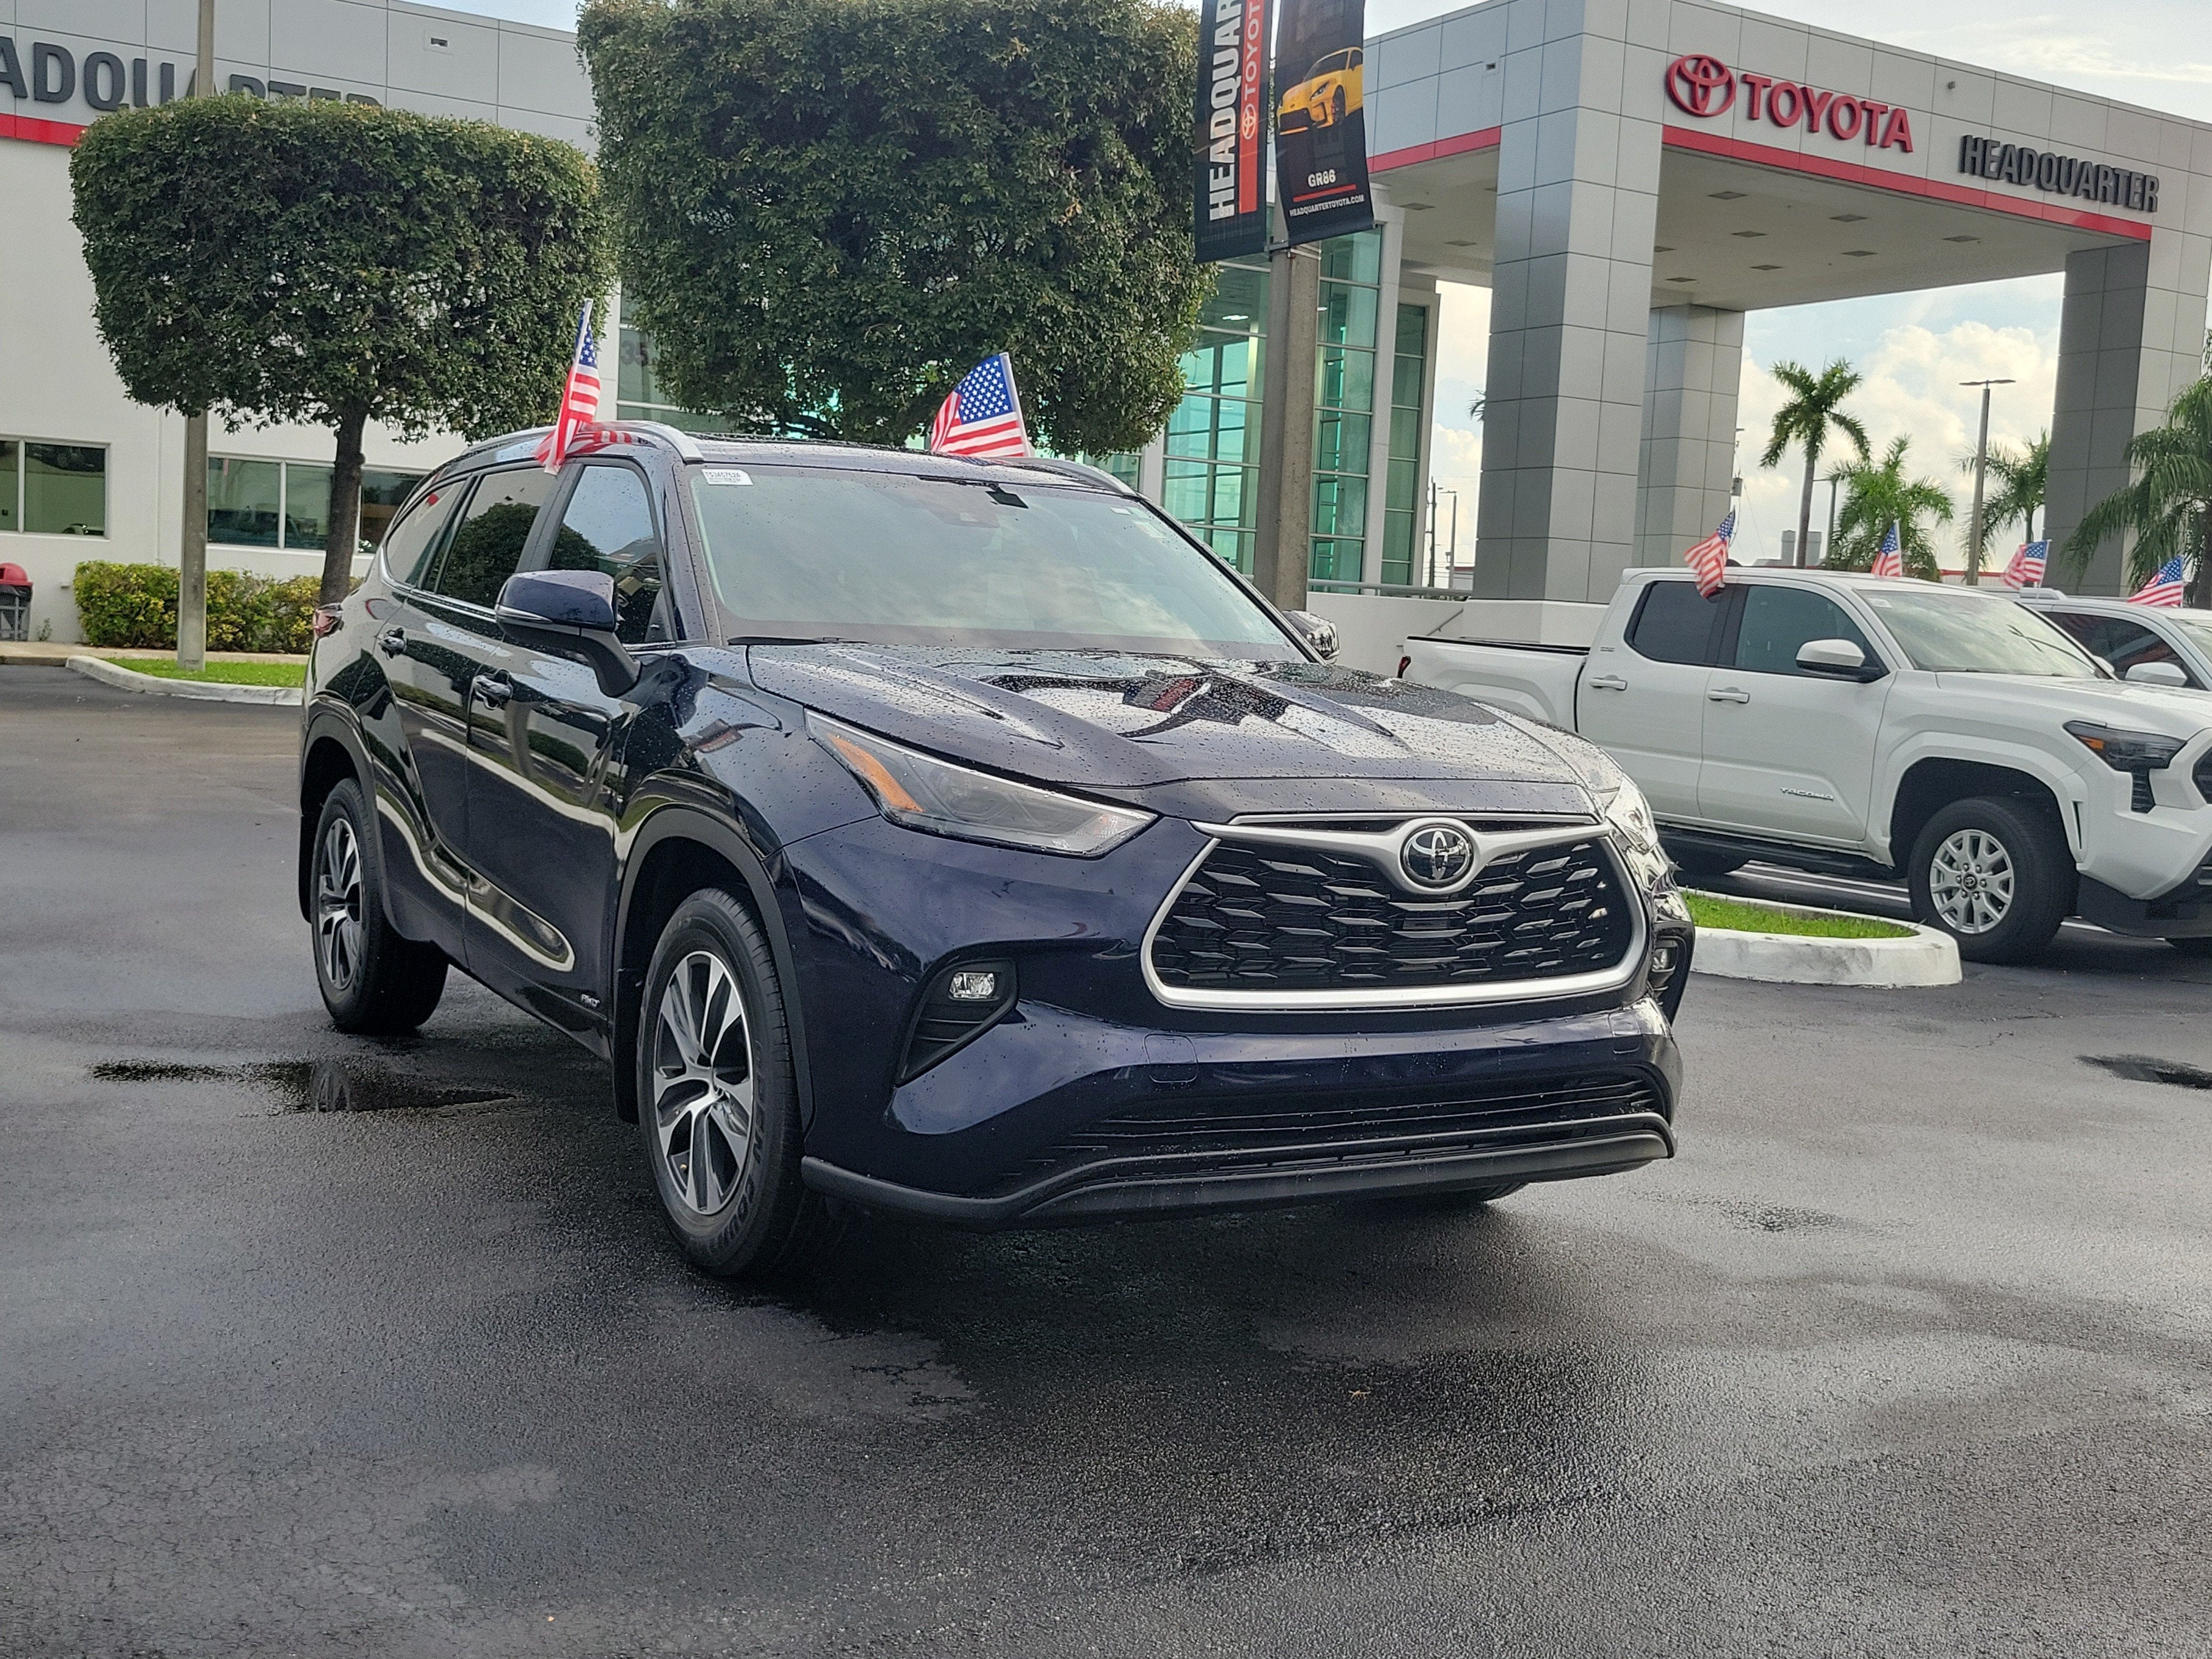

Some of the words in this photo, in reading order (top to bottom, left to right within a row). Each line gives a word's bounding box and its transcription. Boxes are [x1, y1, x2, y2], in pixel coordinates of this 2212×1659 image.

[1742, 73, 1913, 153] TOYOTA
[1308, 169, 1336, 187] GR86
[1959, 134, 2159, 213] HEADQUARTER
[1289, 194, 1364, 217] HEADQUARTERTOYOTA.COM
[1779, 787, 1833, 801] TACOMA
